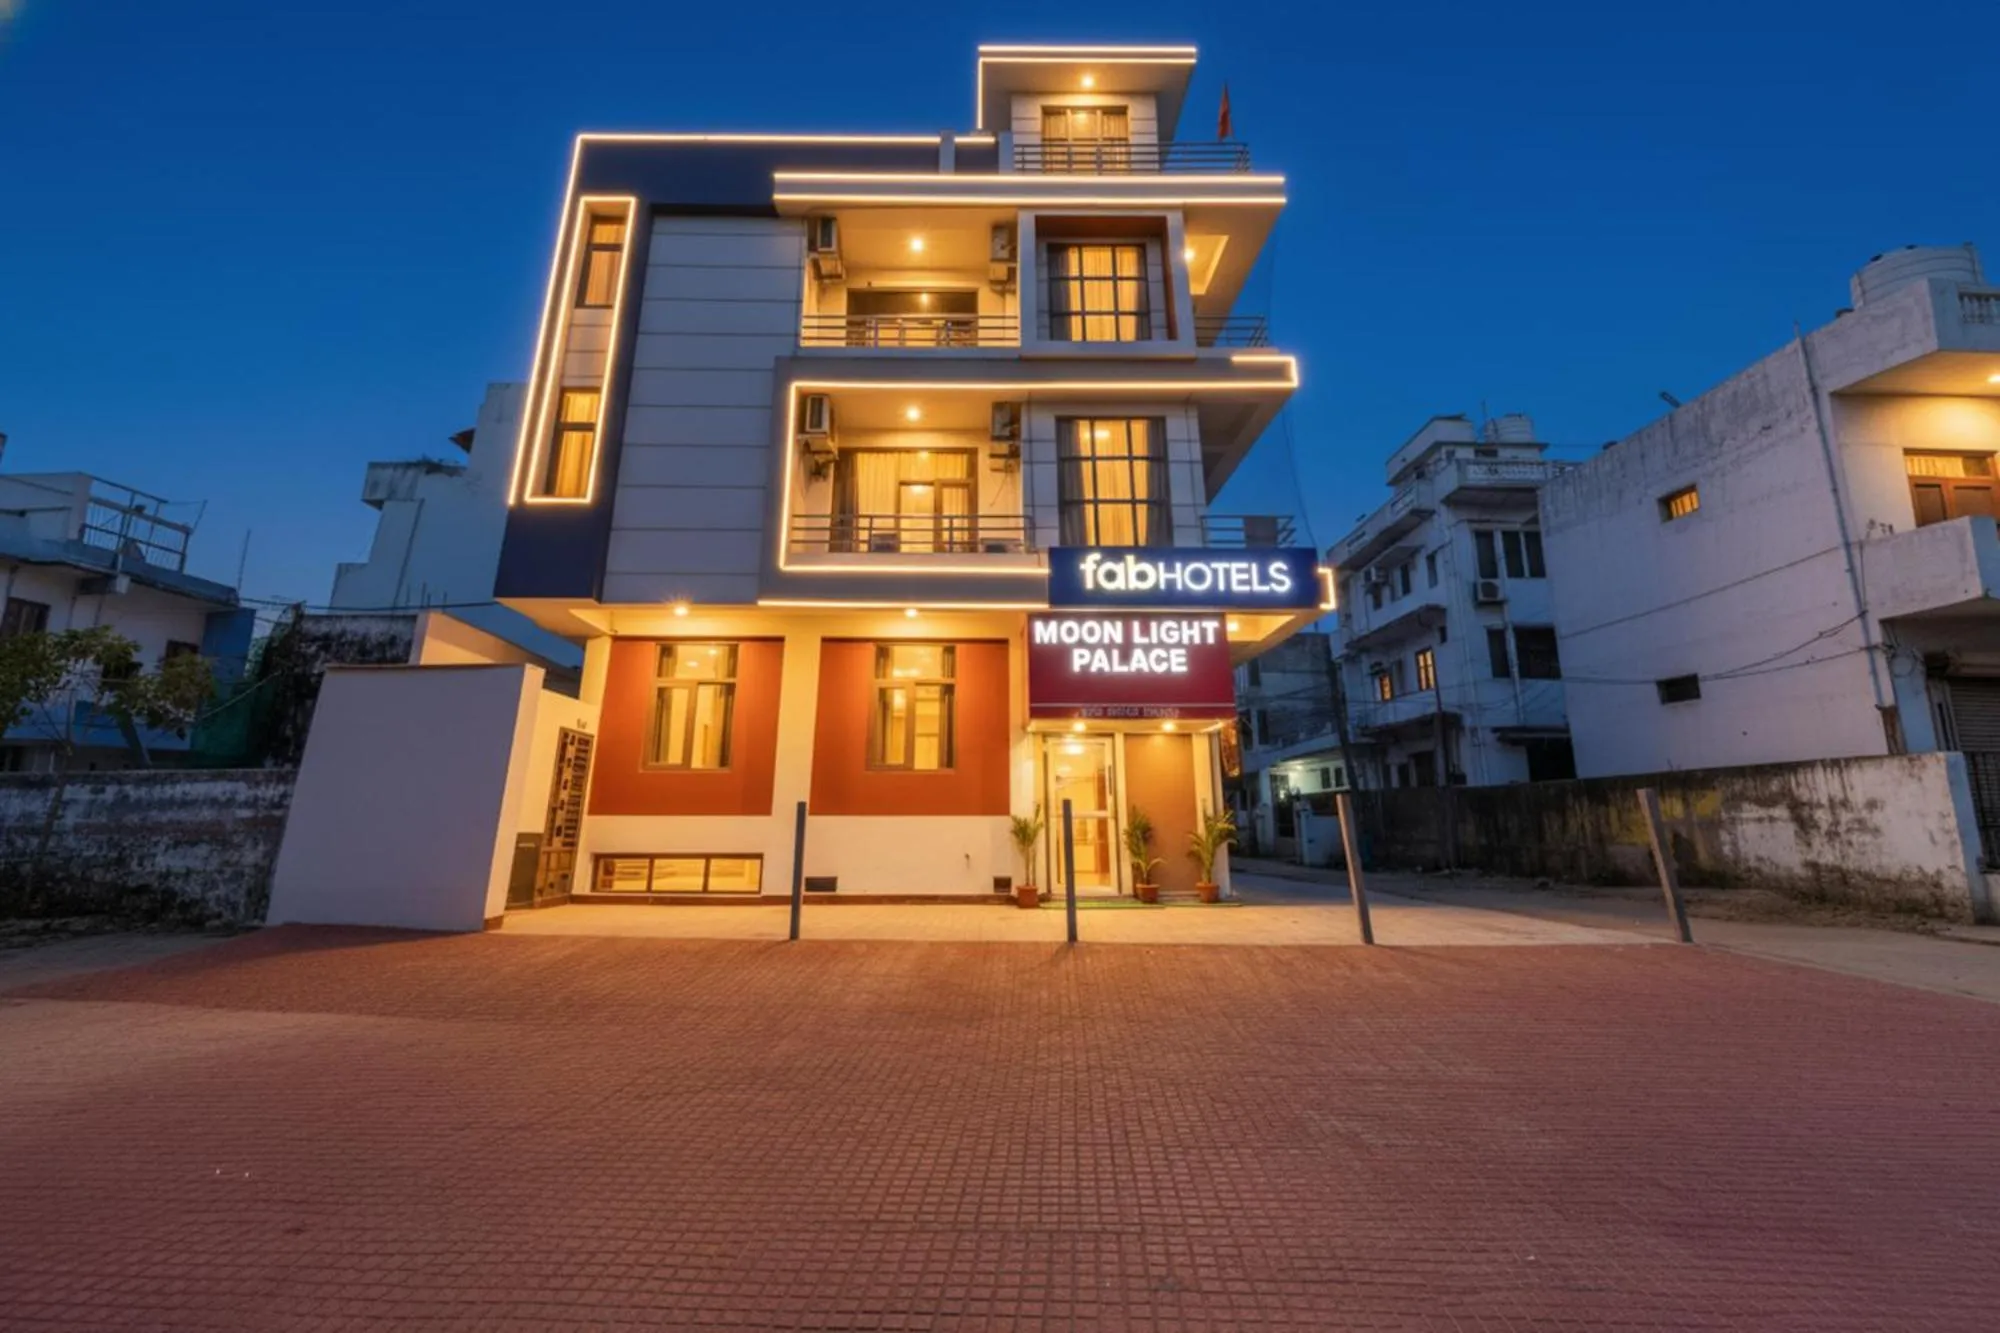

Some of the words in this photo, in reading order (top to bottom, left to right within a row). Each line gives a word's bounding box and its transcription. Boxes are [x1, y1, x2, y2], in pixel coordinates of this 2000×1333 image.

[1080, 553, 1292, 592] fabHOTELS
[1034, 620, 1123, 644] MOON
[1133, 620, 1219, 645] LIGHT
[1072, 648, 1188, 673] PALACE
